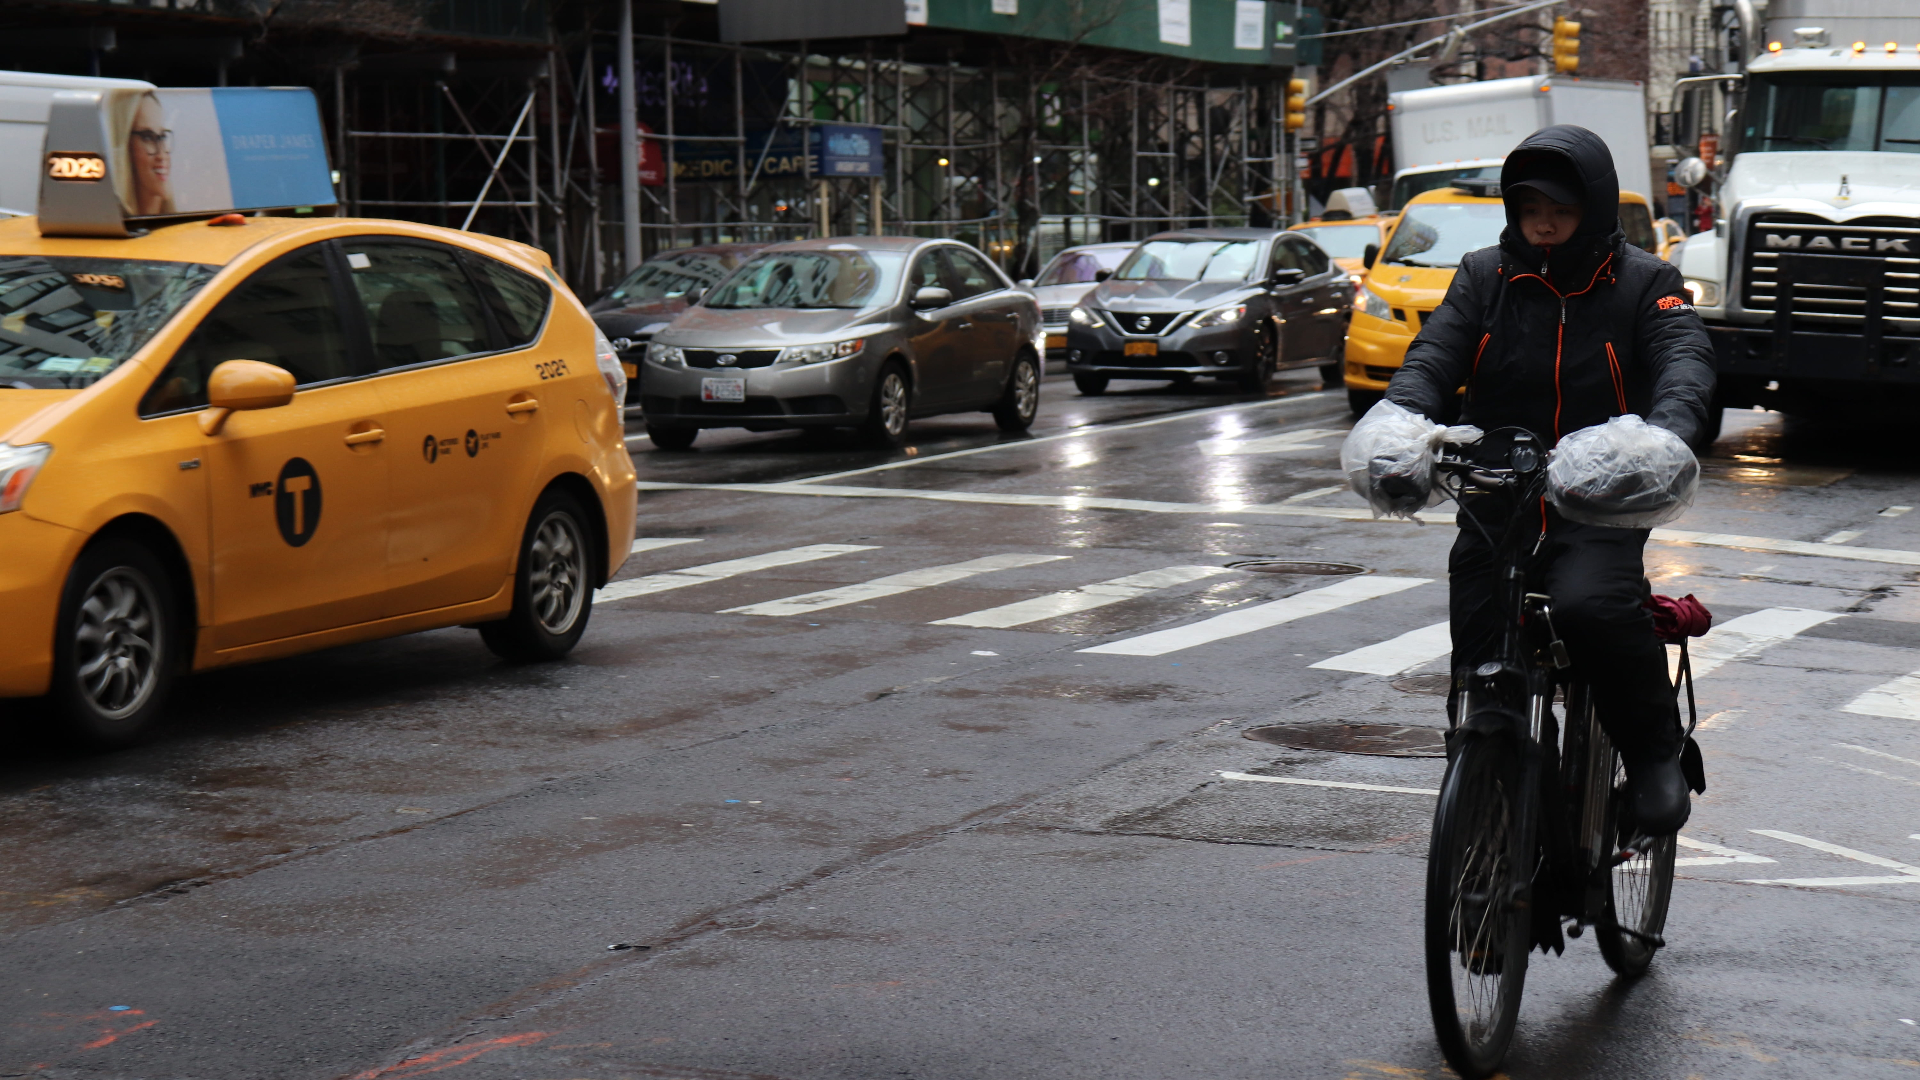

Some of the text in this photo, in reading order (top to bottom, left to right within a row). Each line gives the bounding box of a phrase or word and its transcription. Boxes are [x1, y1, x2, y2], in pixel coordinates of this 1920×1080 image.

[1421, 113, 1514, 144] U.S. MAIL
[231, 133, 315, 150] DRAPER JAMES
[48, 156, 106, 179] 2029
[672, 157, 758, 178] MEDICL
[764, 154, 819, 174] CARE
[1764, 233, 1911, 253] MACK
[535, 358, 571, 380] 2029
